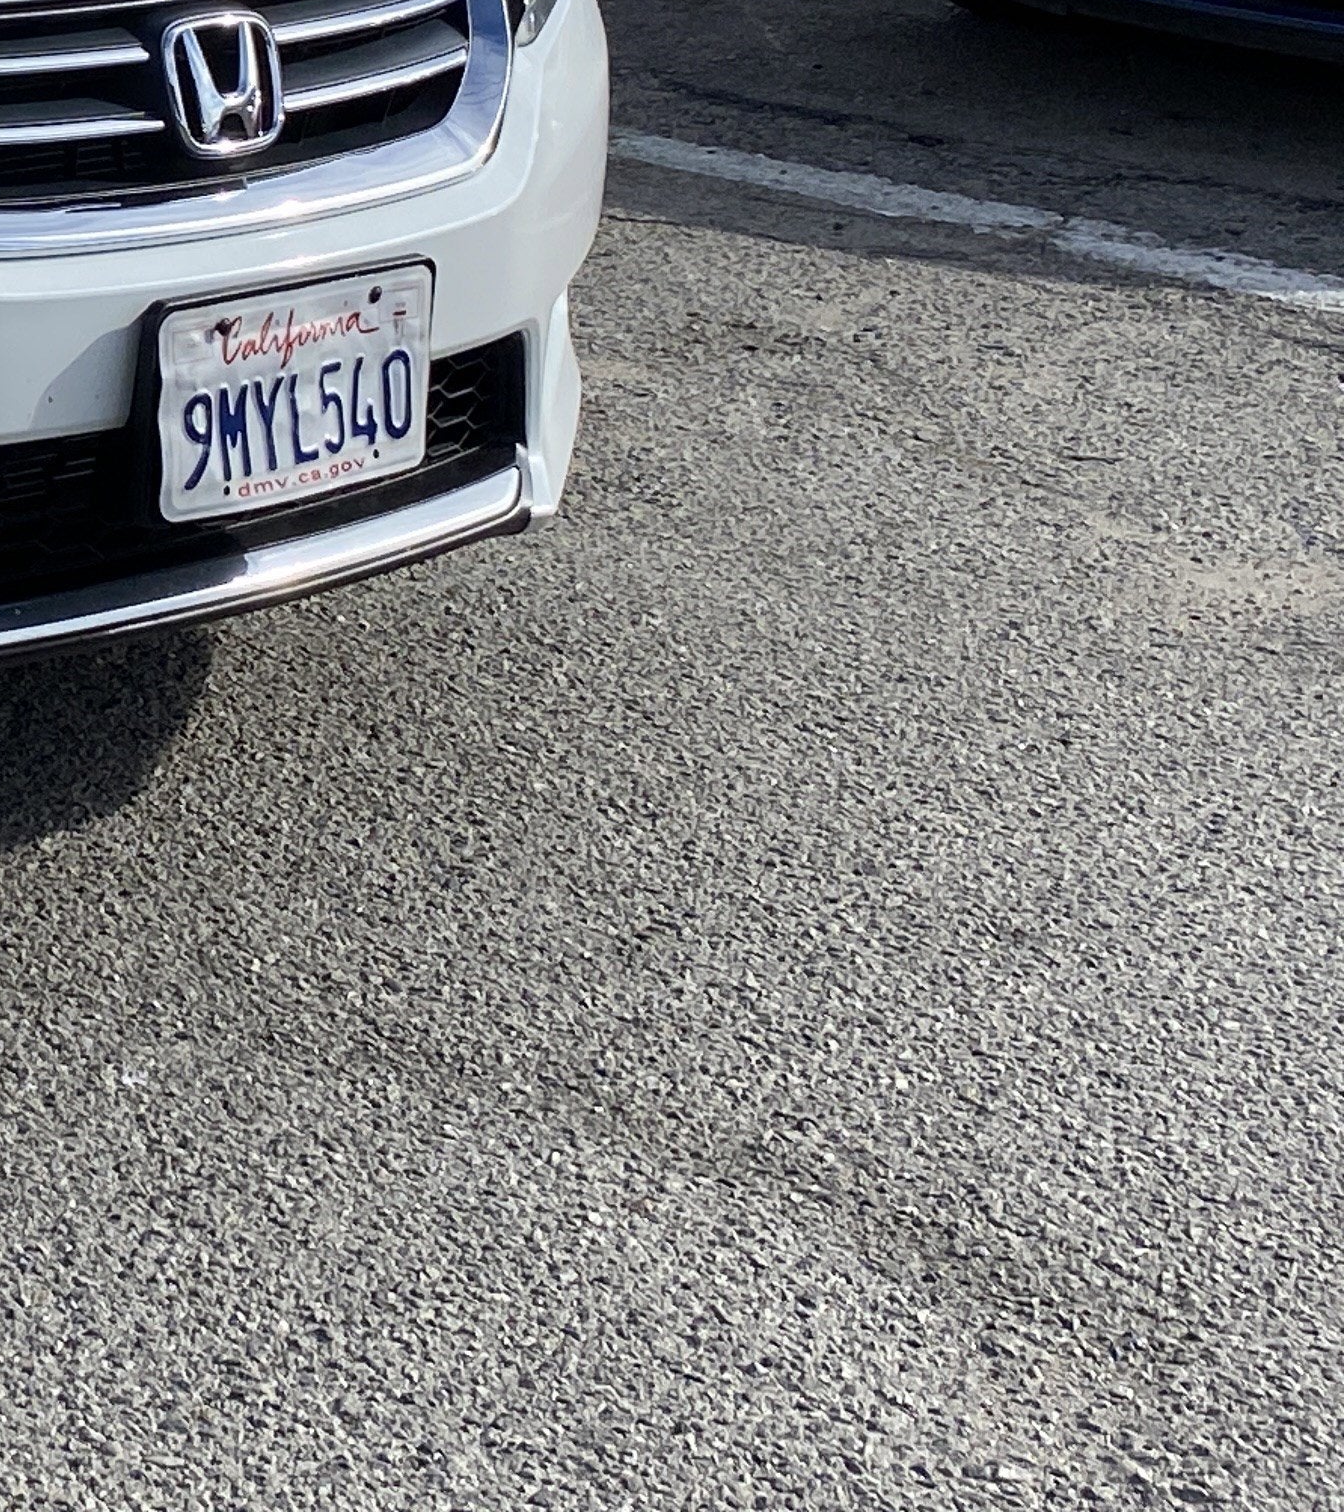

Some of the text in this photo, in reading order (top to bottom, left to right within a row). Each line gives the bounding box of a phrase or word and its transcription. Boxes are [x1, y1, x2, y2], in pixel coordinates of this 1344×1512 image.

[214, 307, 380, 370] California
[182, 348, 413, 491] 9MYL540
[237, 455, 366, 498] dmv.ca.gov
